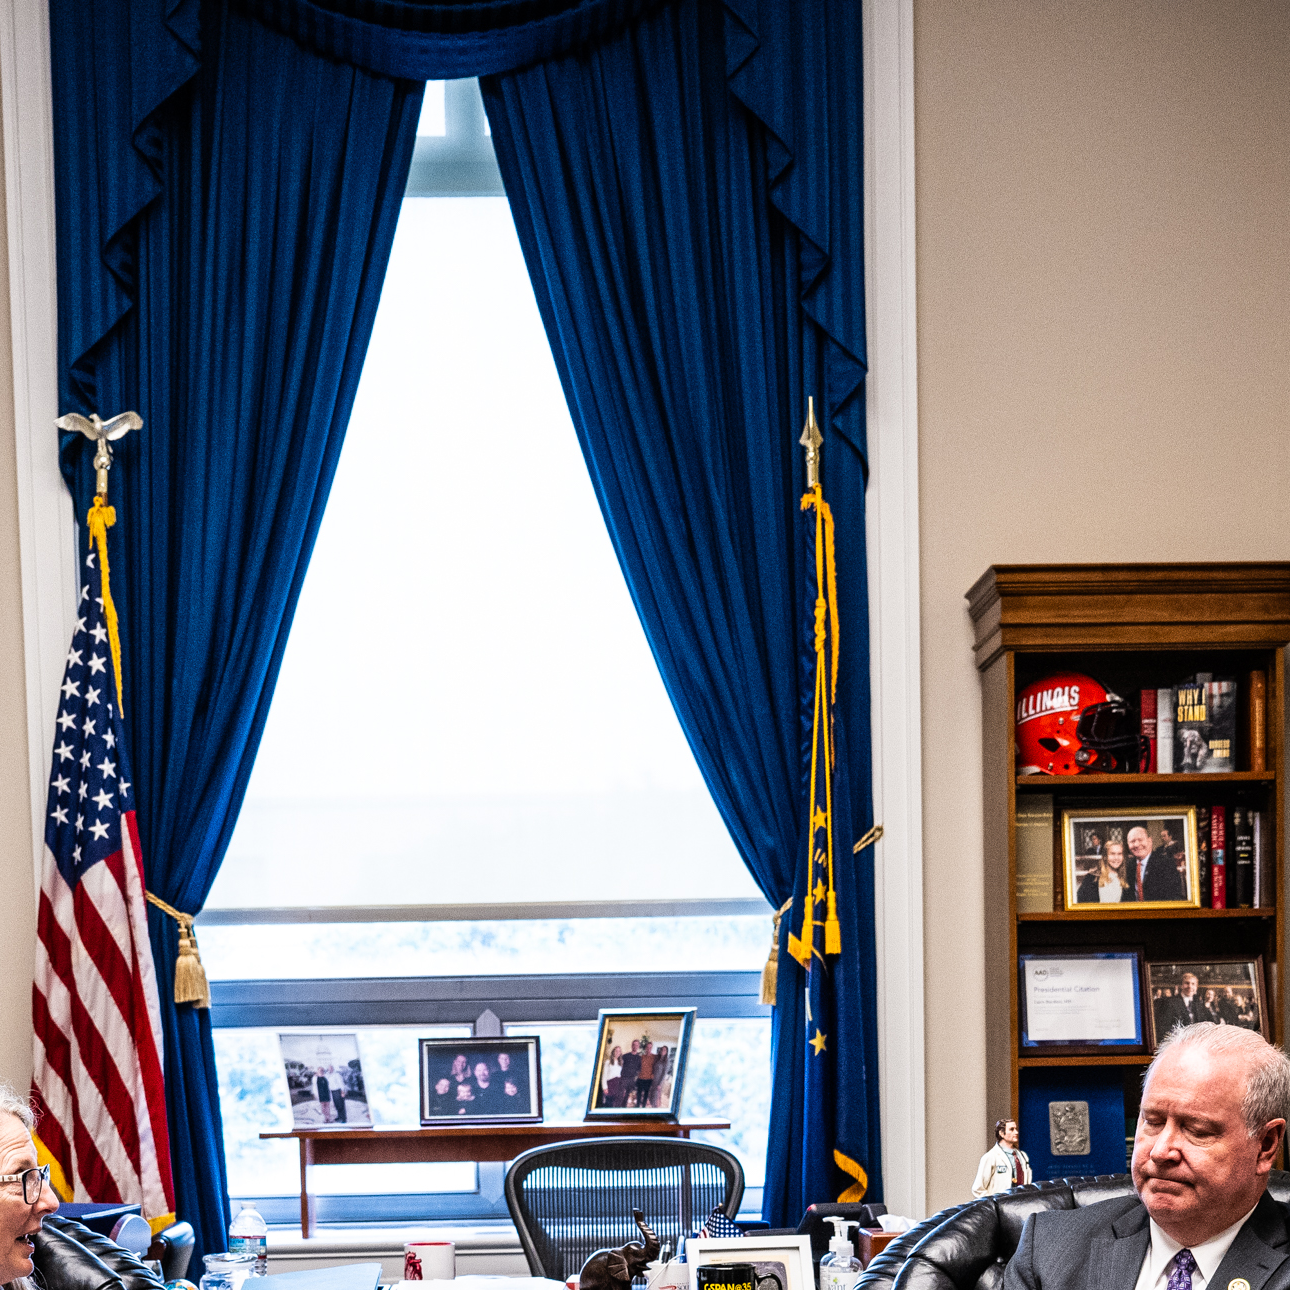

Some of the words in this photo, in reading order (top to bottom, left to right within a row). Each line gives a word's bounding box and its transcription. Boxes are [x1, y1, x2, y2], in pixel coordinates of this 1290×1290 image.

[1017, 685, 1080, 720] ILLINOIS
[1178, 688, 1199, 706] WHY
[1202, 688, 1206, 705] I
[1177, 704, 1206, 722] STAND
